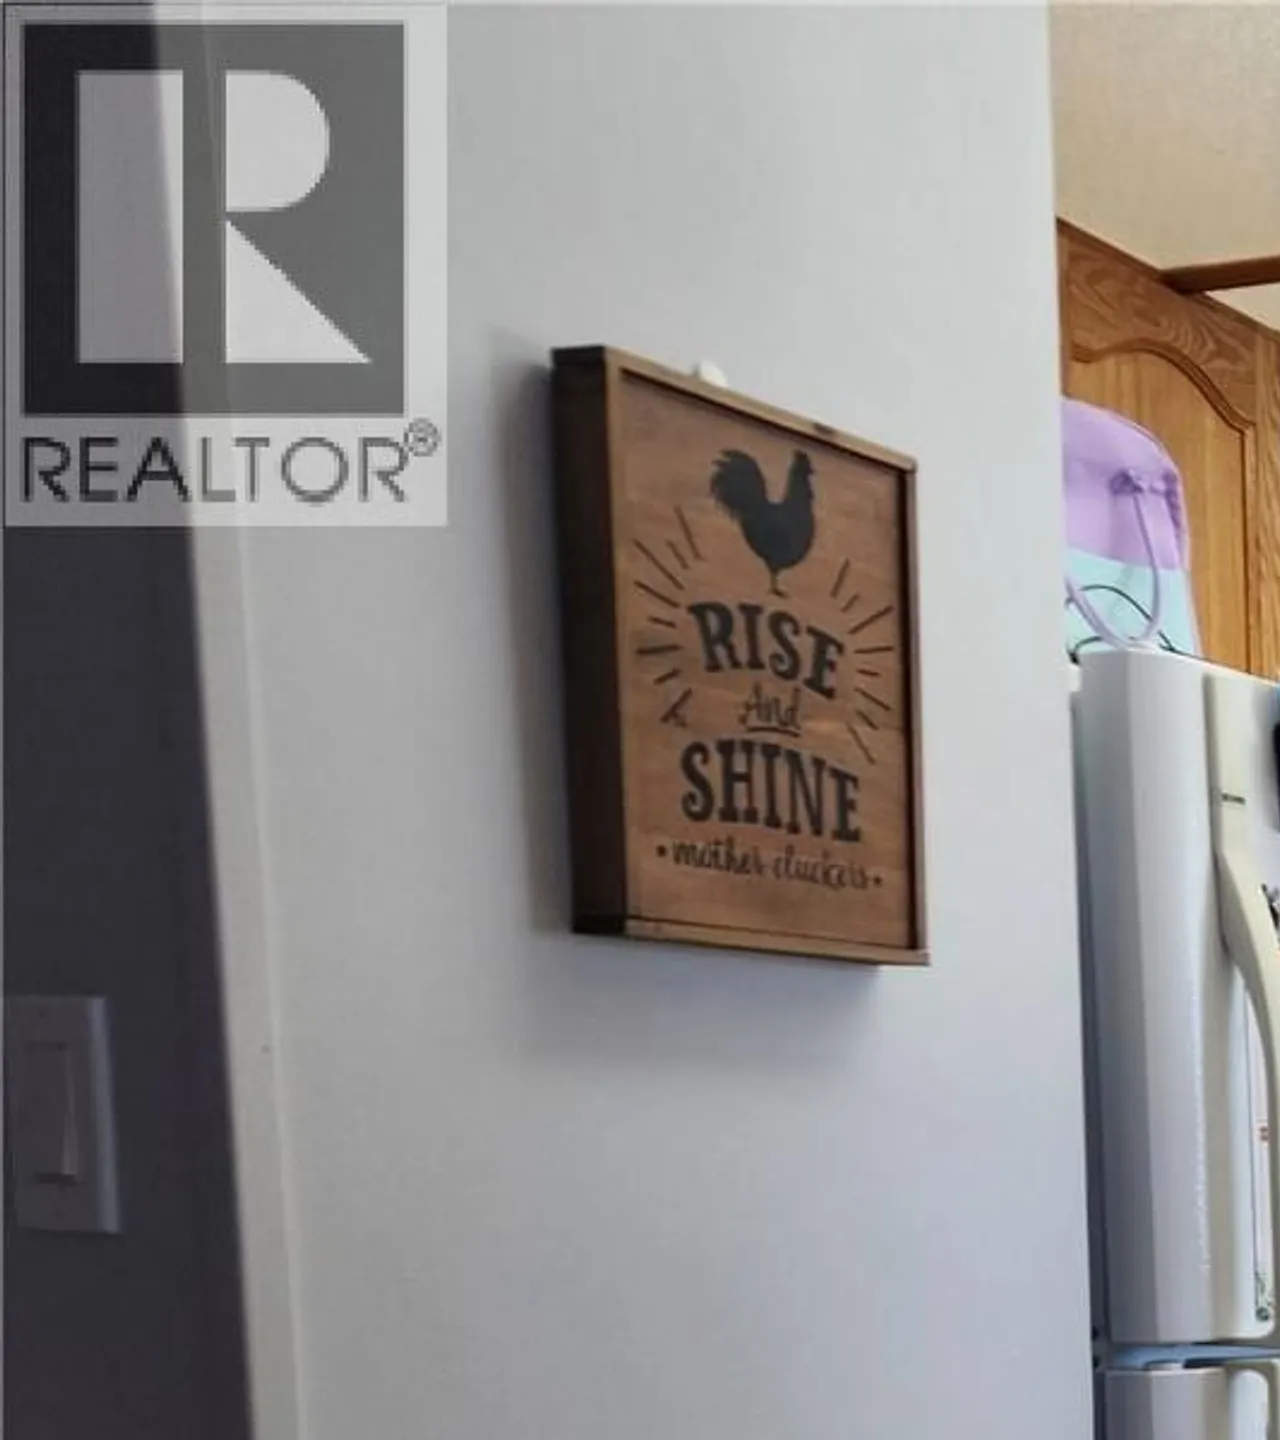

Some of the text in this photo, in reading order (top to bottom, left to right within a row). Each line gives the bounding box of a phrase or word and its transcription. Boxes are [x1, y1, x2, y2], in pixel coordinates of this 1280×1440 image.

[688, 602, 844, 699] RISE
[739, 680, 800, 730] And
[680, 738, 861, 843] SHINE
[672, 837, 869, 890] mother cluckers
